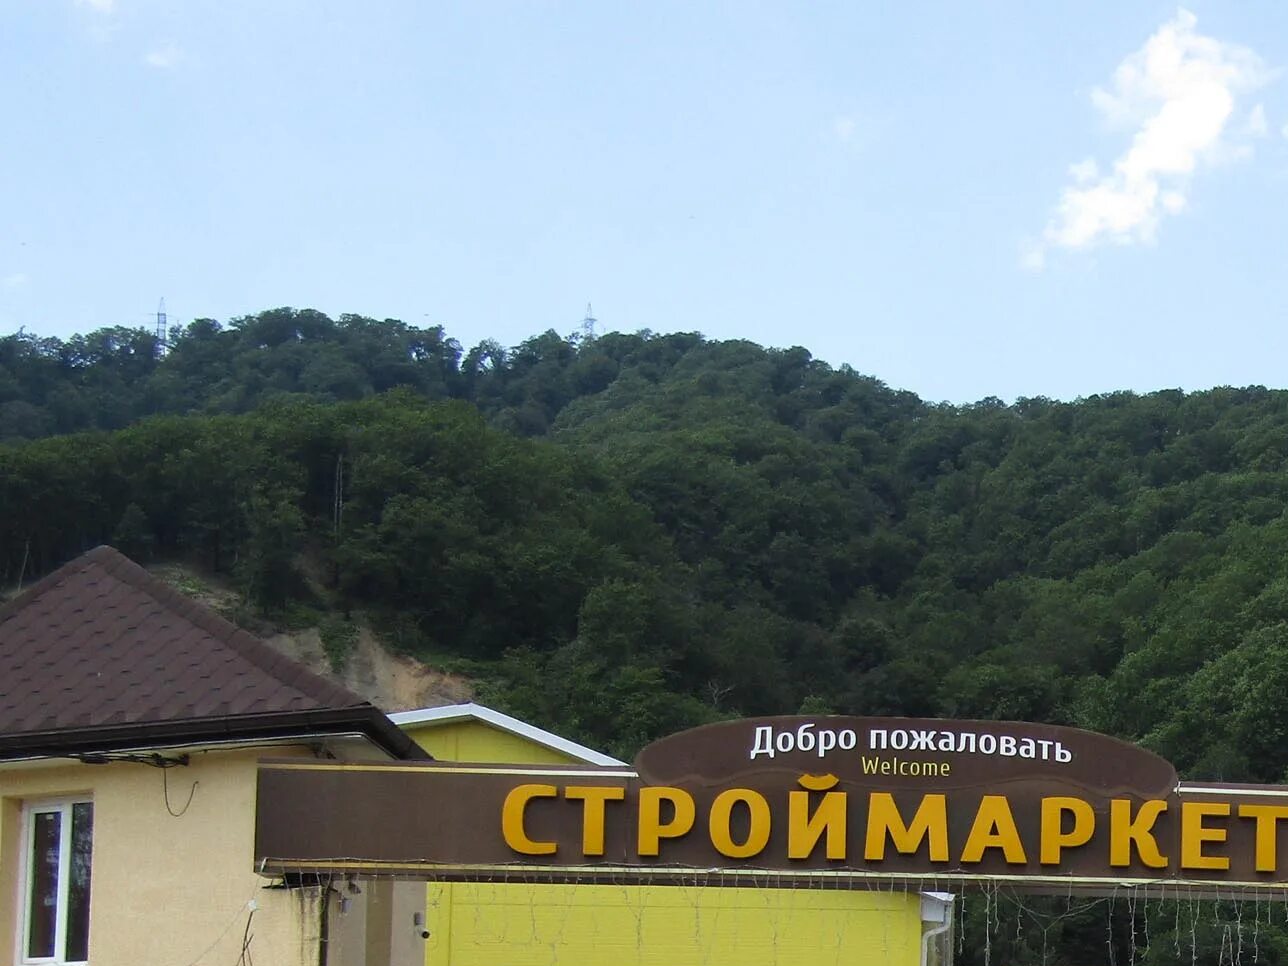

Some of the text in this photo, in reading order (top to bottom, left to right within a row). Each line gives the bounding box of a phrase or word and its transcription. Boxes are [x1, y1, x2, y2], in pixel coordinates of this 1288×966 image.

[750, 723, 1073, 763] Добро пожаловать
[861, 756, 951, 776] Welcome
